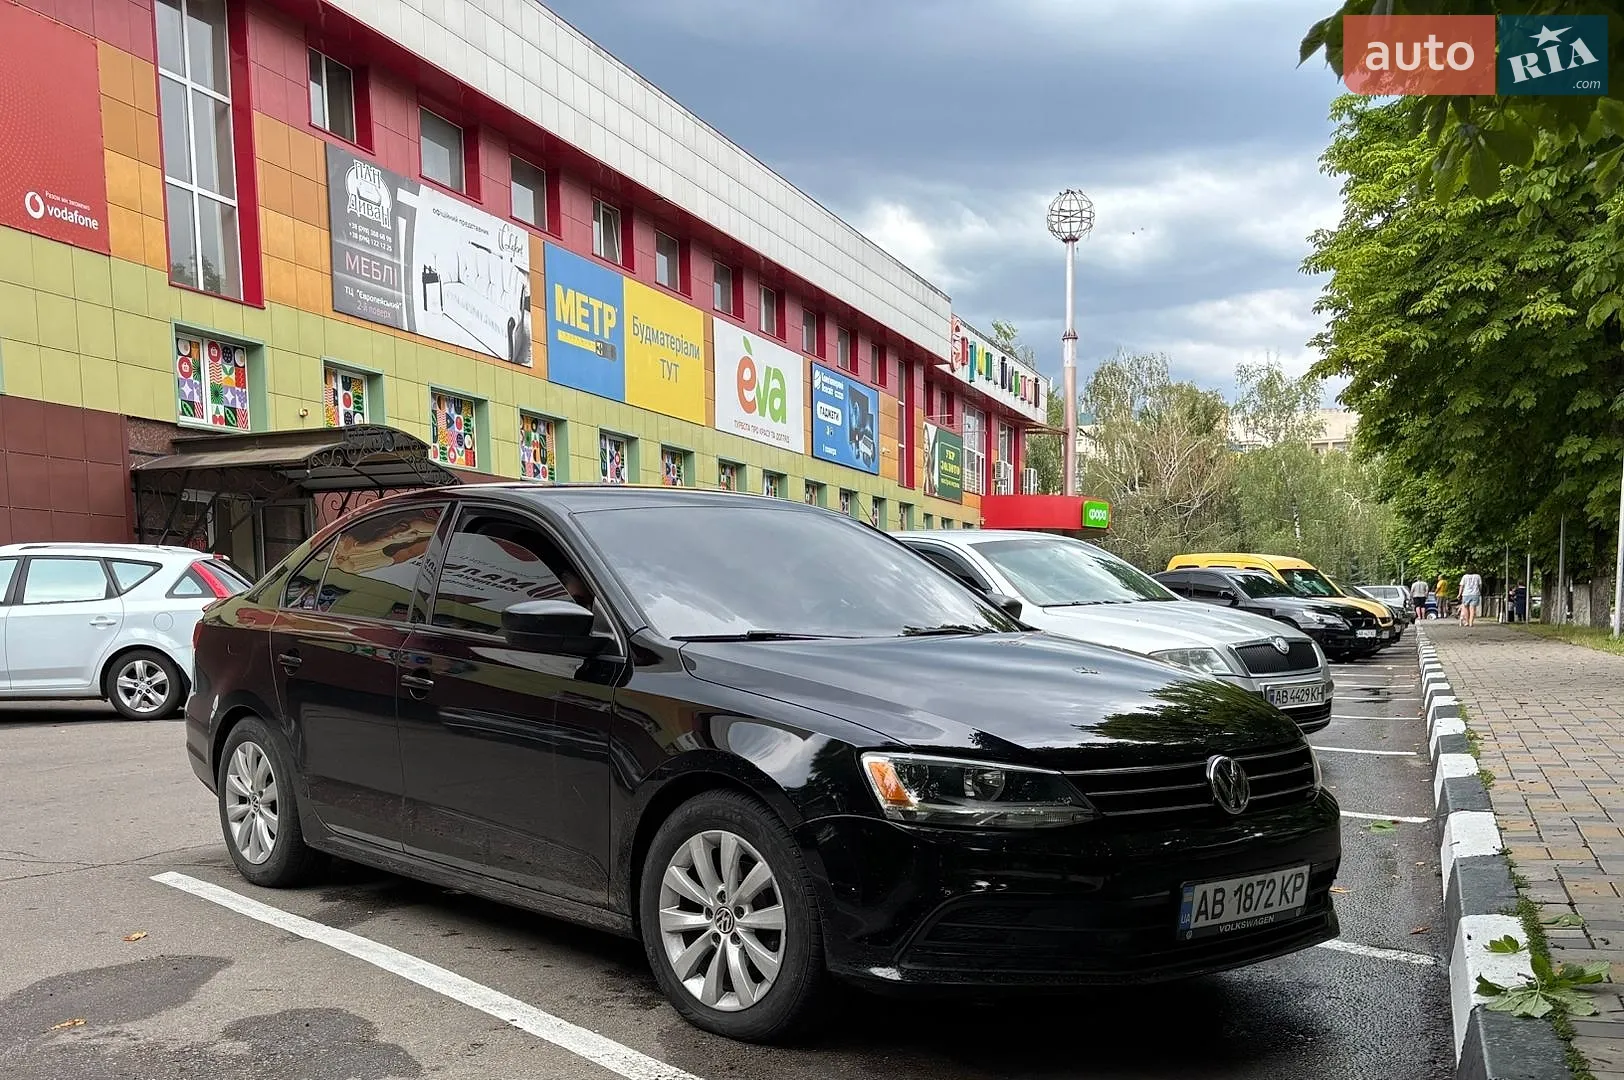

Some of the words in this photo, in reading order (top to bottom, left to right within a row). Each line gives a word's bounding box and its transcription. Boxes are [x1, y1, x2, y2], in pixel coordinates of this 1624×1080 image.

[353, 159, 381, 189] ПАН
[46, 204, 99, 230] vodafone
[344, 250, 398, 289] МЕБЛІ
[344, 285, 354, 297] ТЦ
[554, 283, 617, 339] МЕТР
[632, 315, 701, 361] Будматеріали
[660, 358, 680, 384] ТУТ
[819, 406, 841, 422] ГАДЖЕТИ
[1275, 690, 1289, 705] AB
[1289, 687, 1310, 702] 4429
[1194, 887, 1226, 923] AB
[1233, 878, 1276, 915] 1872
[1278, 872, 1305, 907] KP
[1180, 912, 1191, 925] UA
[1219, 914, 1275, 934] VOLKSWAGEN
